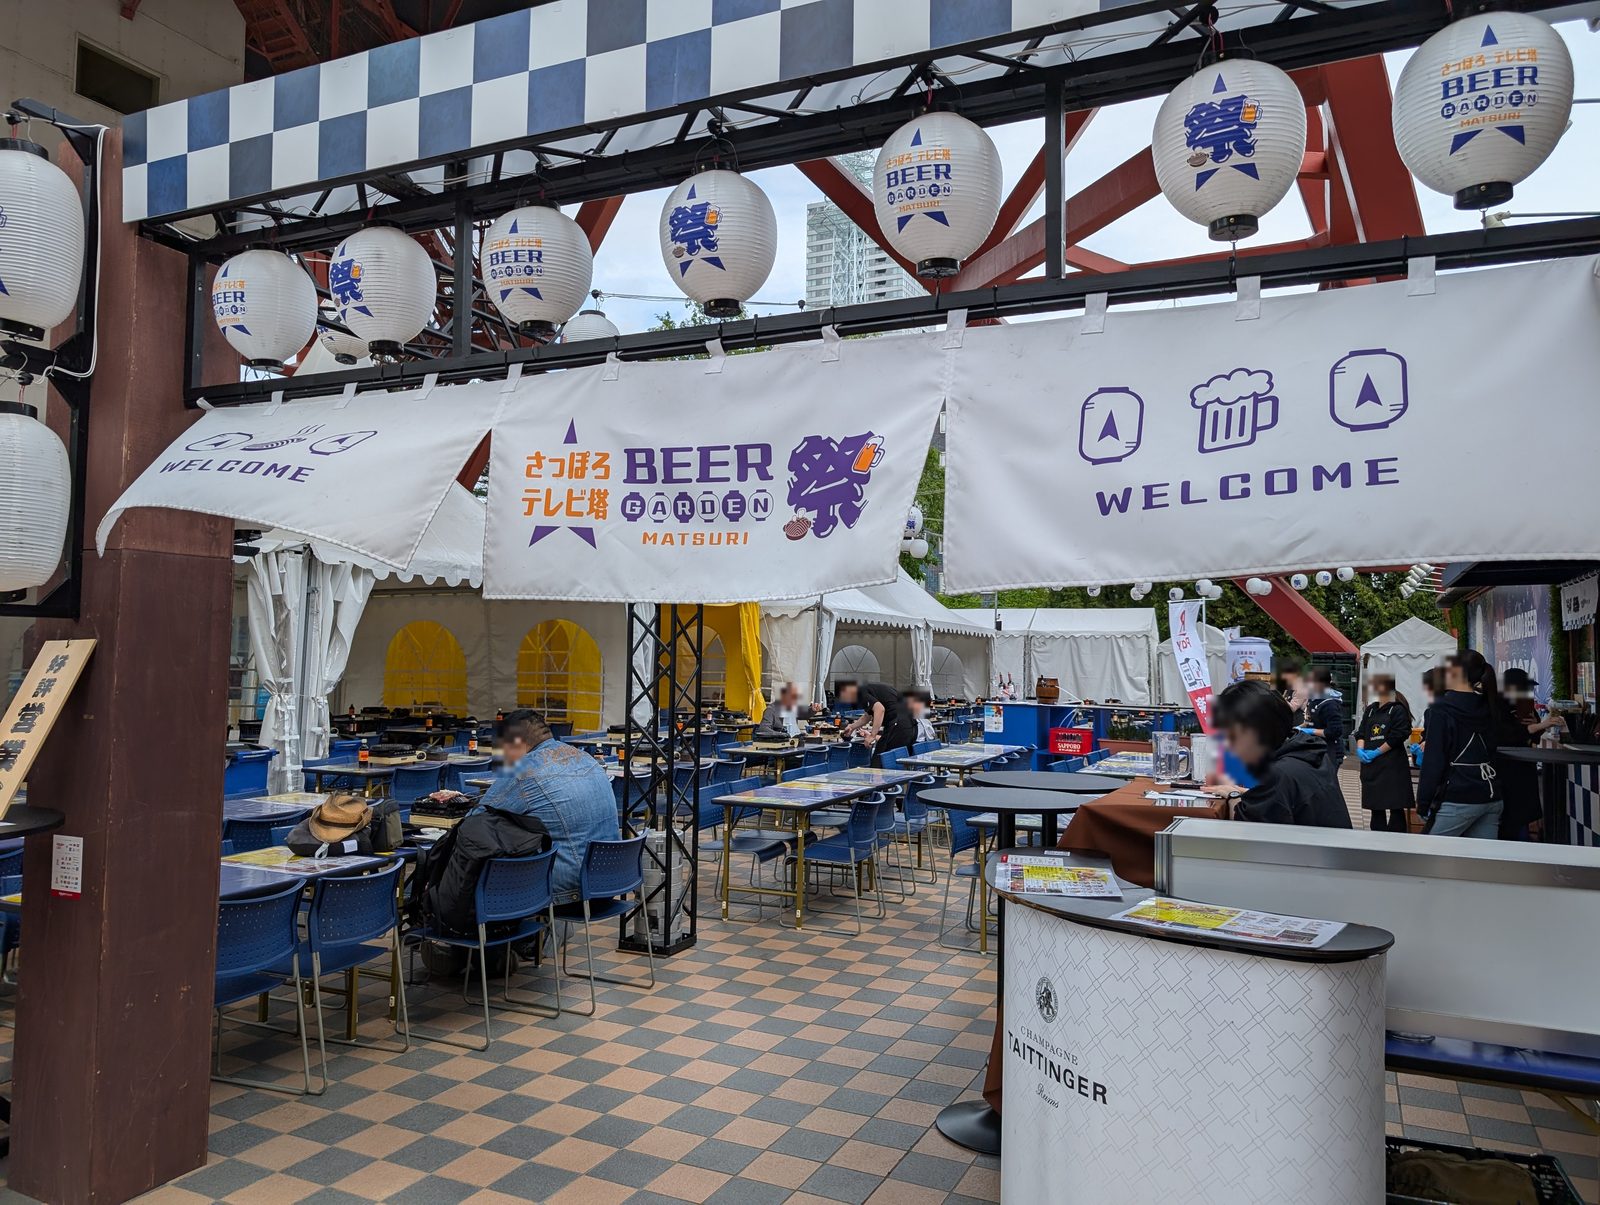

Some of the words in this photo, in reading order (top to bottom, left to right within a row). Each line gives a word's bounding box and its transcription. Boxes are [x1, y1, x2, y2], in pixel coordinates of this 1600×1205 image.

[1441, 54, 1486, 76] さっぽろ
[1494, 48, 1538, 64] テレビ塔
[1441, 66, 1539, 100] BEER
[1441, 90, 1539, 118] GARDEN
[1184, 95, 1258, 163] 祭
[1461, 112, 1521, 127] MATSURI
[886, 163, 952, 189] BEER
[888, 183, 952, 204] GARDEN
[899, 200, 941, 212] MATSURI
[669, 201, 720, 256] 祭
[490, 250, 544, 266] BEER
[491, 265, 543, 279] GARDEN
[159, 459, 315, 482] WELCOME
[525, 451, 611, 480] さっぽろ
[623, 443, 774, 484] BEER
[787, 431, 875, 538] 祭
[1096, 457, 1400, 517] WELCOME
[522, 488, 610, 520] テレビ塔
[622, 491, 773, 522] GARDEN
[642, 532, 748, 545] MATSURI
[0, 654, 69, 791] 好評営業
[1057, 742, 1081, 750] SAPPORO
[1021, 1026, 1078, 1066] CHAMPAGNE
[1008, 1030, 1108, 1105] TAITTINGER
